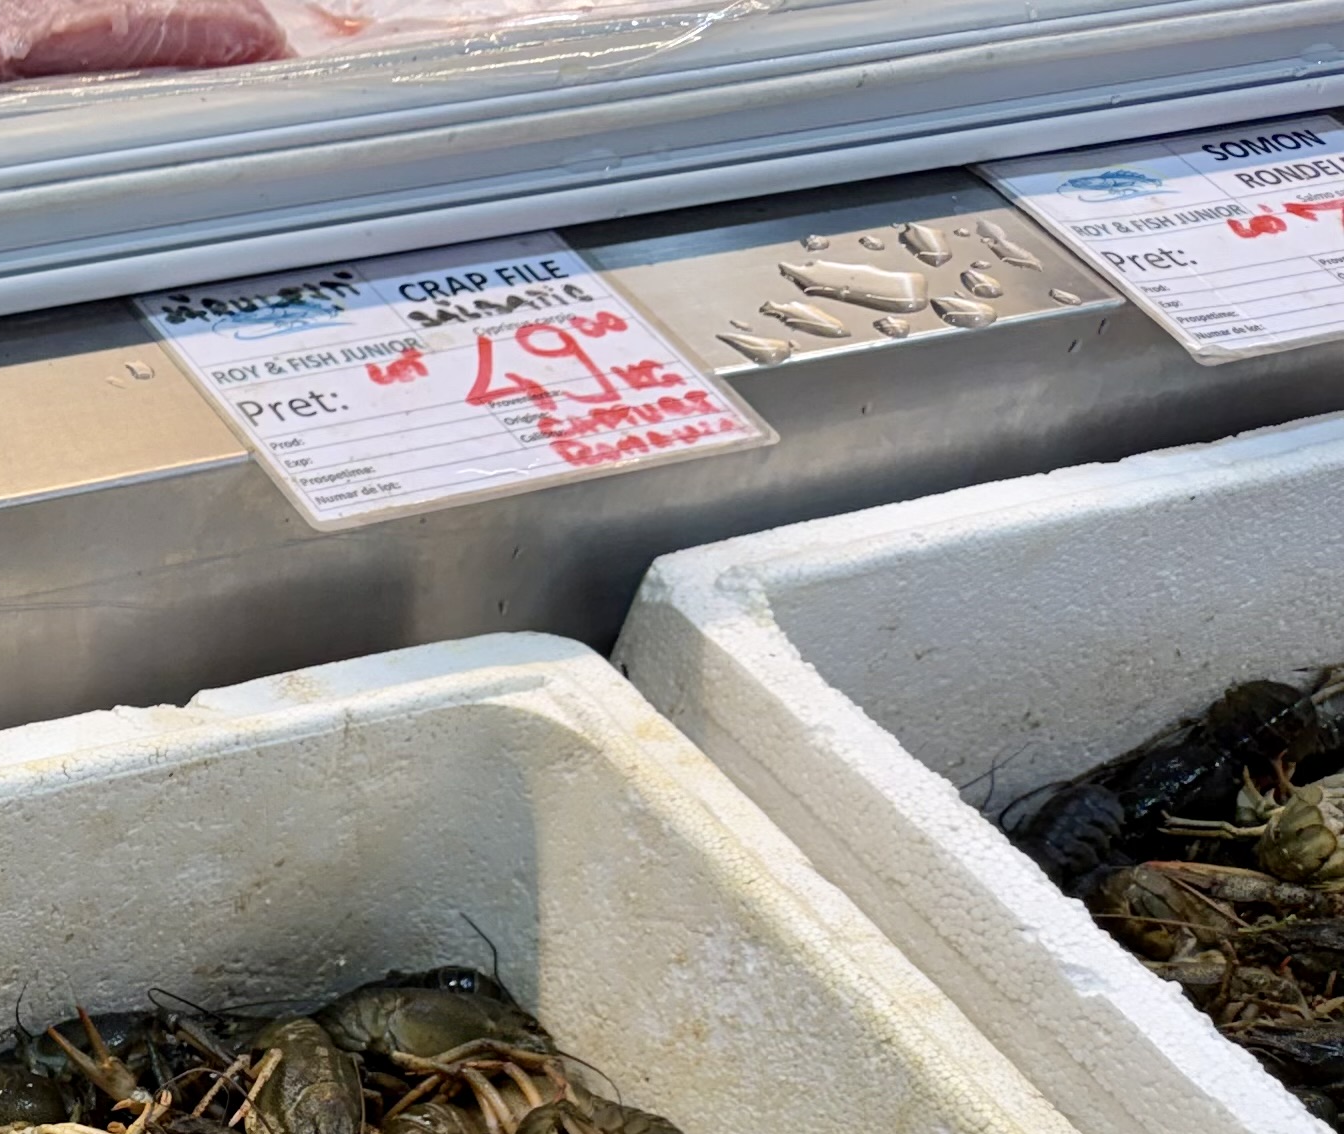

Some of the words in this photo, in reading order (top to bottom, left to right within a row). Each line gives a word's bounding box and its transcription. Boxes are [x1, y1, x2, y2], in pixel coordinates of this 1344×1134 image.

[1202, 129, 1326, 161] SOMON
[1234, 156, 1344, 188] RONDEL
[1071, 223, 1107, 238] ROY
[1111, 220, 1131, 233] &
[1131, 213, 1176, 233] FISH
[1174, 203, 1247, 227] JUNIOR
[1100, 247, 1198, 273] Pret:
[398, 270, 489, 302] CRAP
[494, 259, 569, 287] FILE
[211, 366, 260, 385] ROY
[265, 361, 287, 376] &
[285, 353, 337, 373] FISH
[339, 337, 425, 363] JUNIOR
[236, 389, 350, 428] Pret:
[269, 437, 305, 451] Prod:
[284, 457, 313, 470] Exp:
[299, 465, 377, 487] Prospetime:
[315, 489, 358, 506] Numar
[361, 484, 378, 496] de
